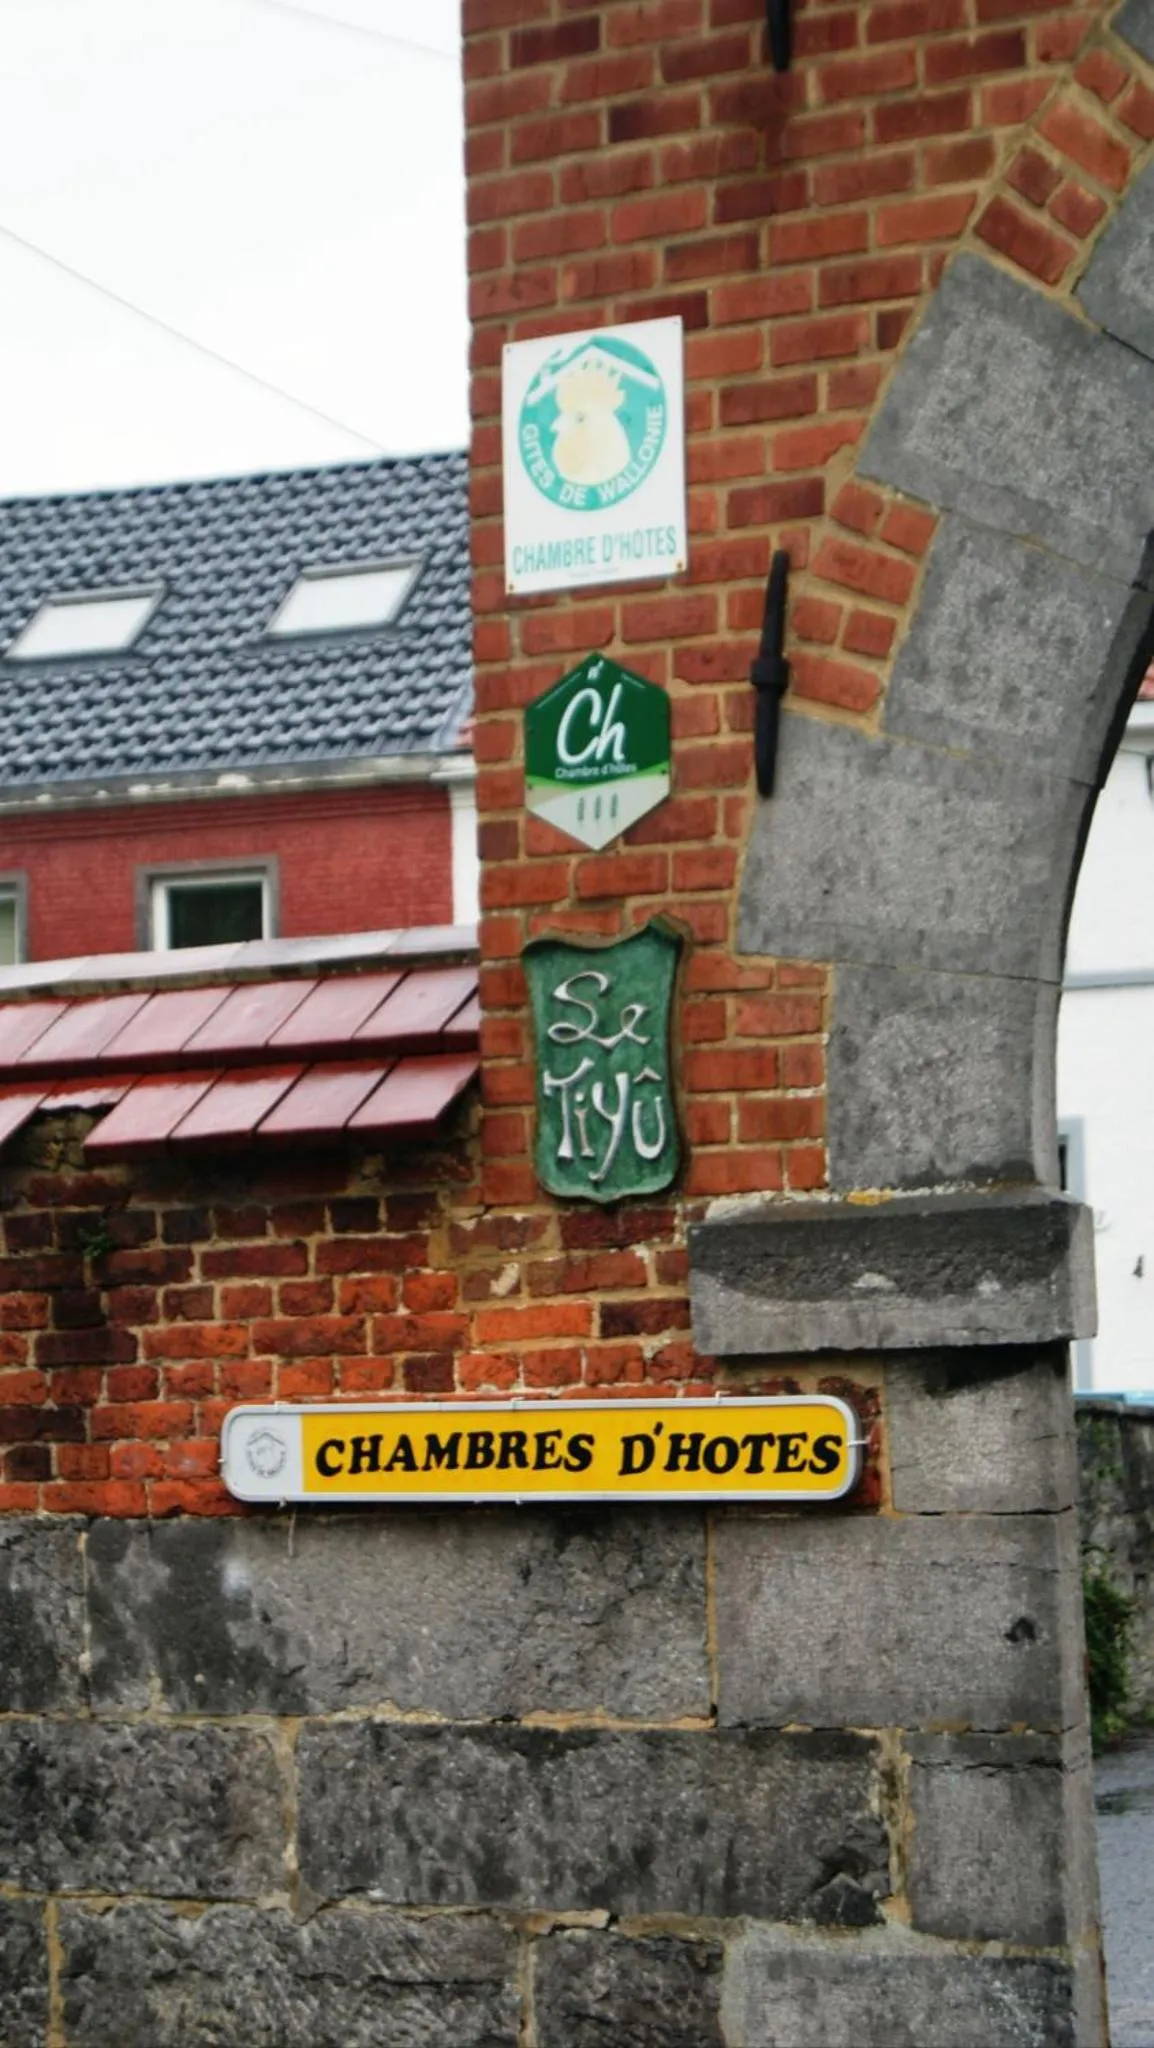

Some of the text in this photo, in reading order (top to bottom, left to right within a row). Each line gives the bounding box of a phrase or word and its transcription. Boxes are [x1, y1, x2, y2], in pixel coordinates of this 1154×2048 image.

[560, 483, 586, 505] DE
[598, 404, 663, 502] WALLONIE
[513, 535, 596, 574] CHAMBRE
[557, 683, 625, 765] Ch
[555, 765, 599, 779] Chambre
[315, 1429, 595, 1477] CHAMBRES
[618, 1421, 842, 1475] D'HOTES
